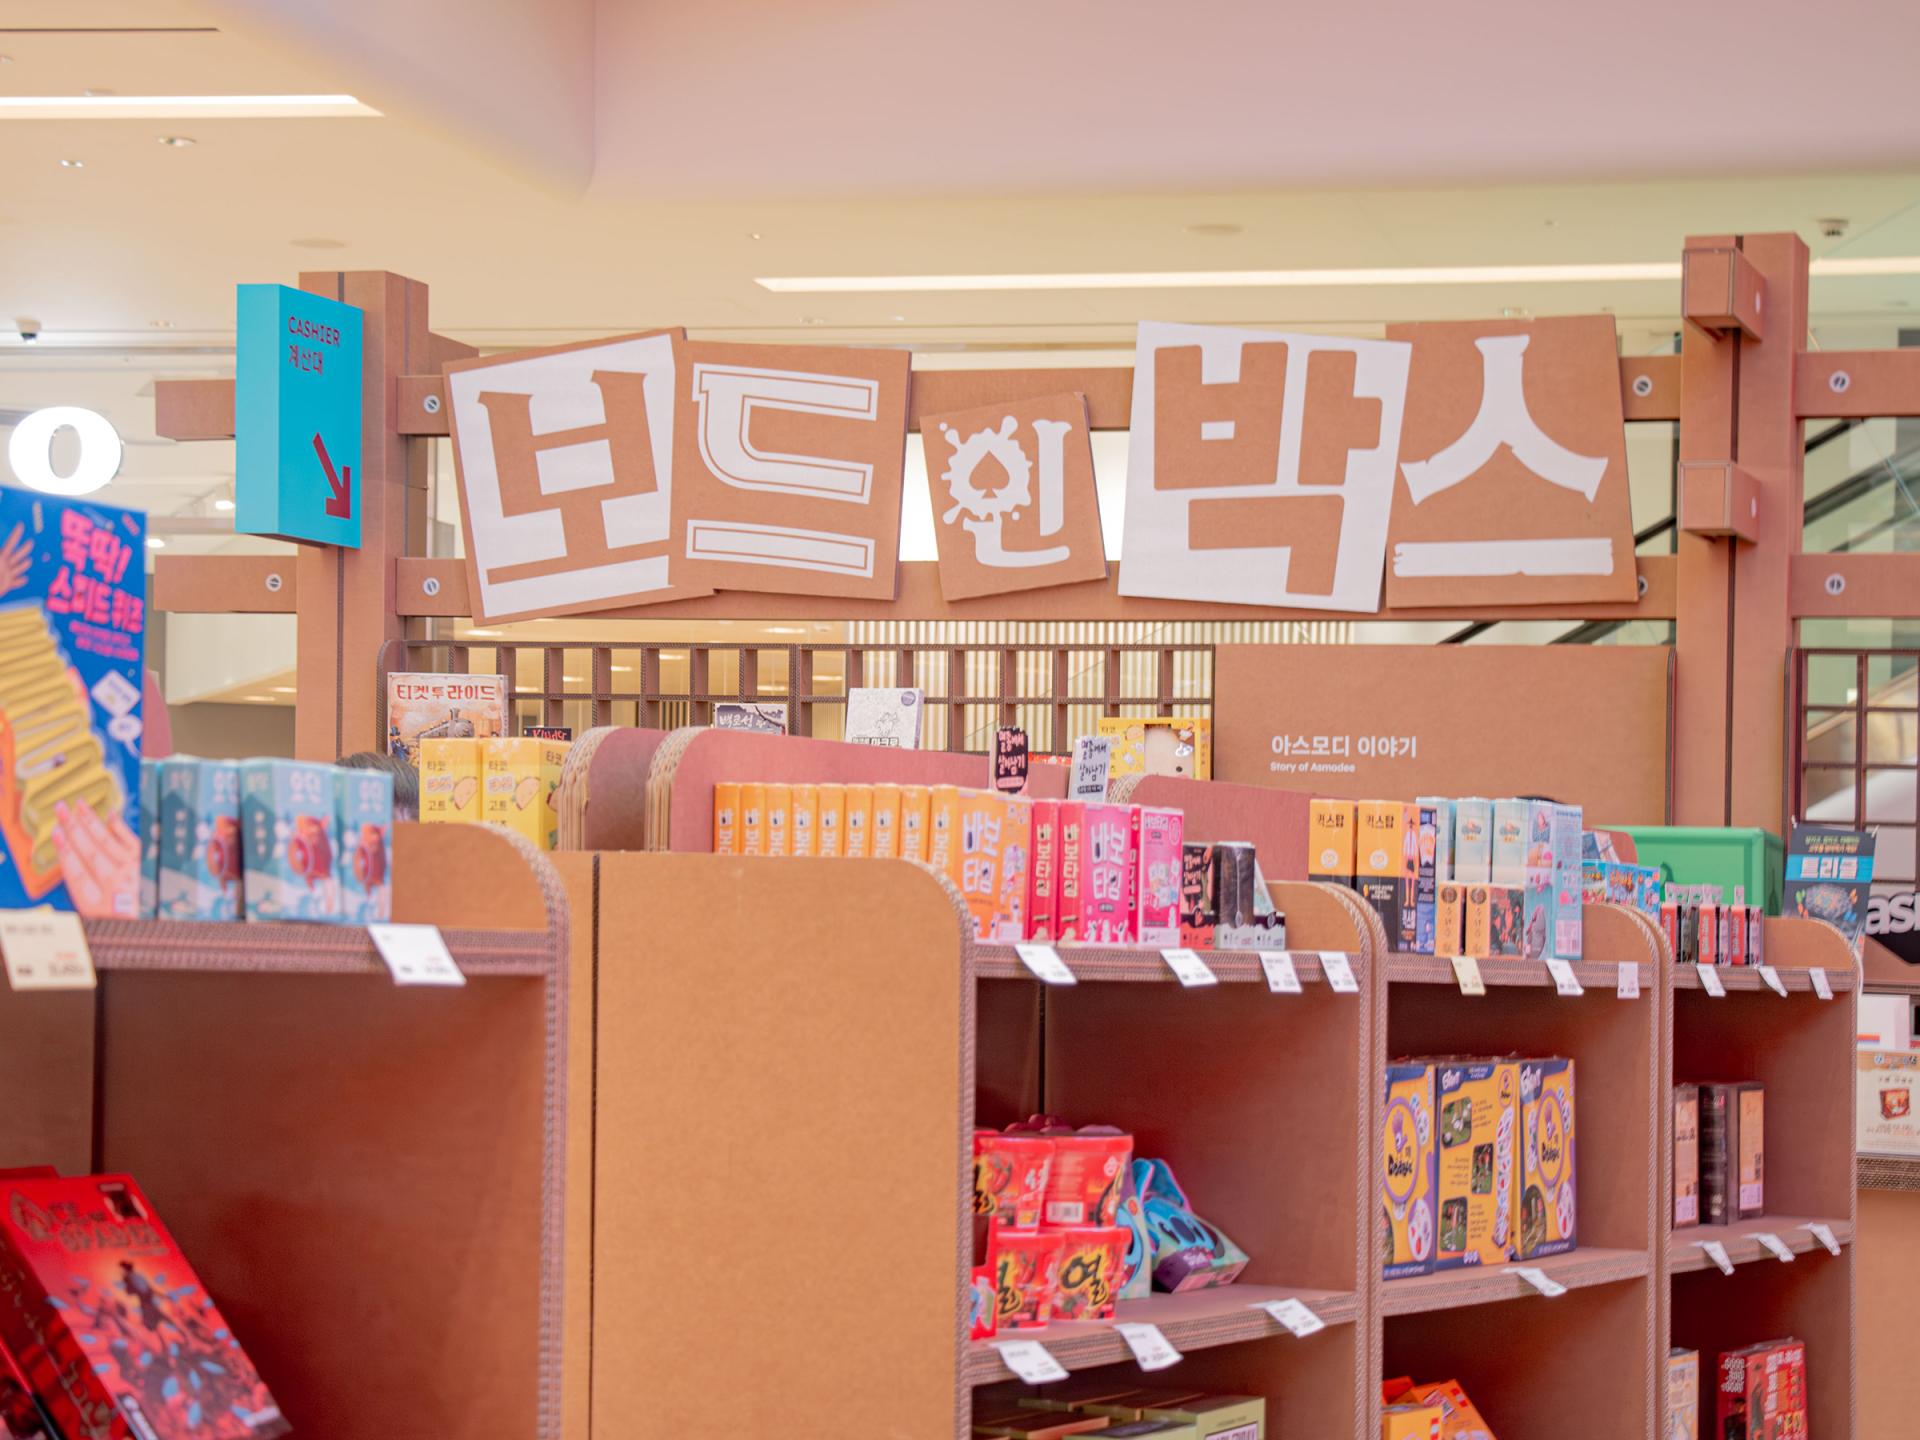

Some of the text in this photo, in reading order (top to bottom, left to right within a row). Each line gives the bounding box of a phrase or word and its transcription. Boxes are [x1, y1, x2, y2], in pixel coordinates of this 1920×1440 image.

[288, 316, 340, 347] CASHIER
[288, 344, 323, 375] 계산대
[1271, 735, 1417, 759] 아스모디 이야기
[1270, 761, 1356, 773] Story of Asmodee
[962, 811, 1002, 857] 바보
[1090, 822, 1127, 867] 바보
[962, 858, 996, 895] 타임
[1092, 866, 1123, 901] 타임
